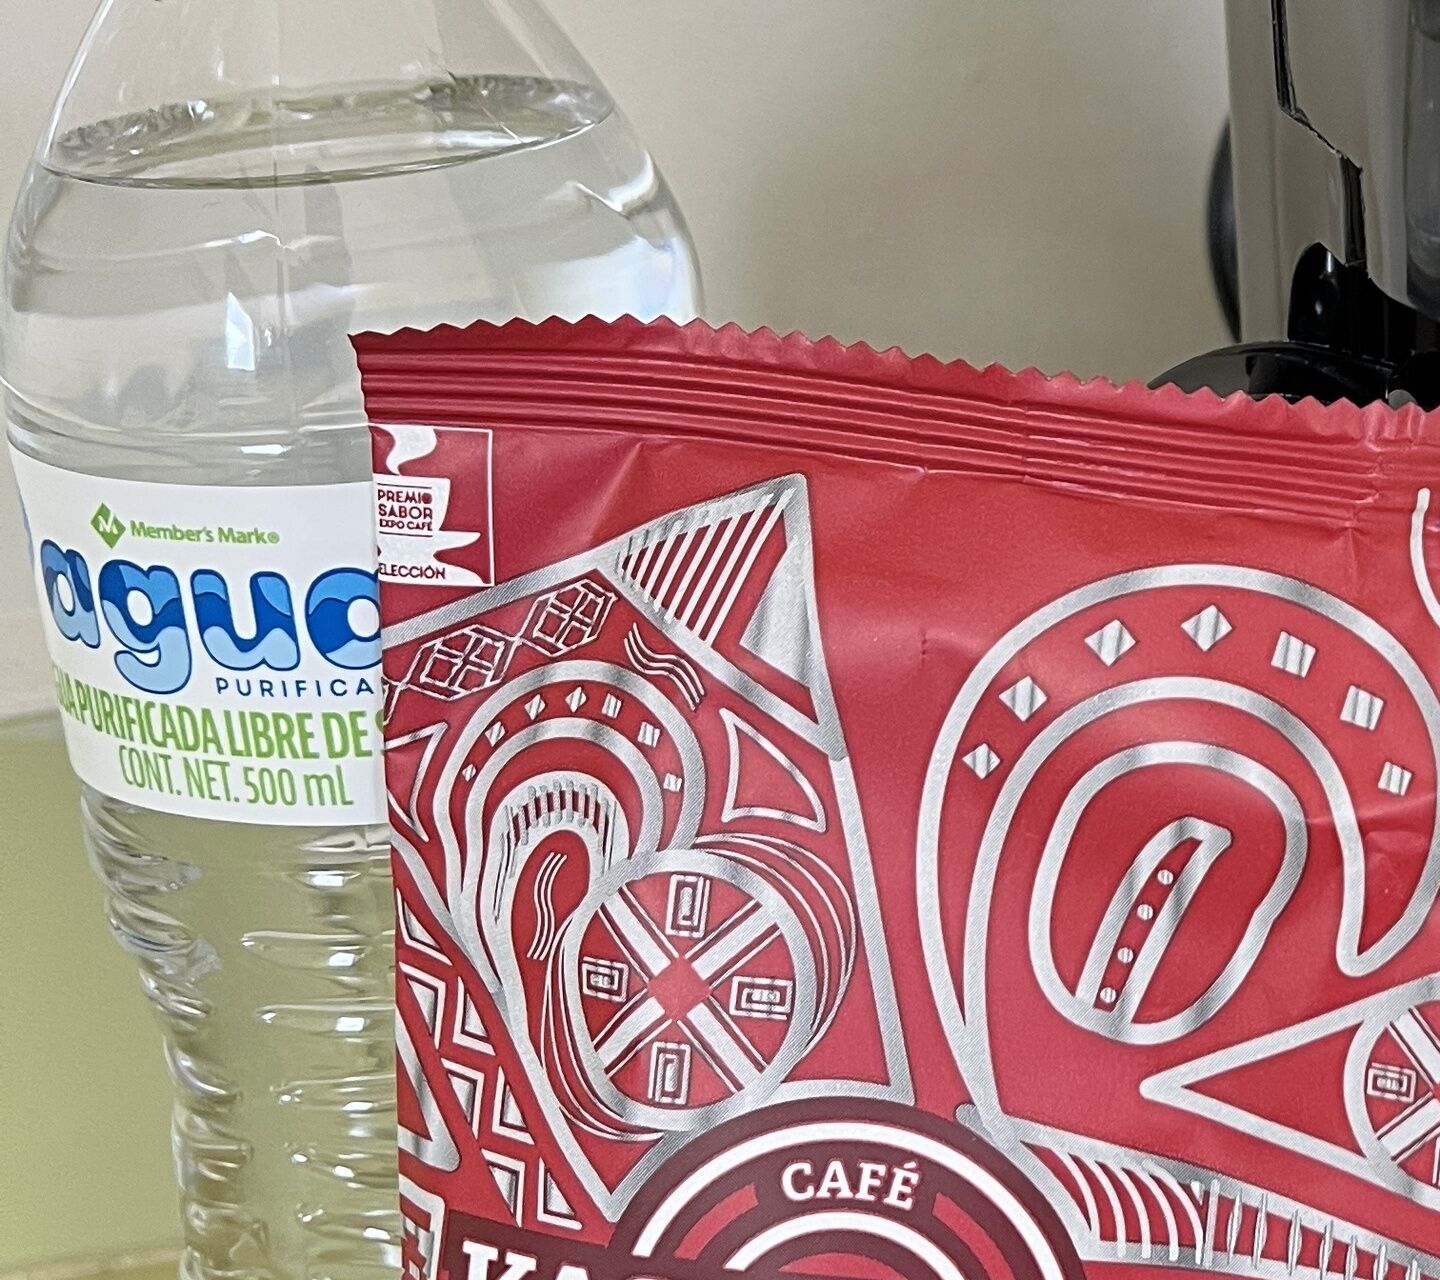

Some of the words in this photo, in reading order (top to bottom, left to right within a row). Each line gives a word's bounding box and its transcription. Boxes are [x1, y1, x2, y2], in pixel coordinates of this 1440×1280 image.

[377, 488, 433, 505] PREMIO
[378, 503, 433, 520] SABOR
[130, 520, 215, 543] Member's
[215, 676, 375, 698] PURIFICA
[75, 678, 225, 756] PURIFICADA
[223, 708, 321, 760] LIBRE
[321, 710, 373, 760] DE
[118, 745, 182, 796] CONT.
[182, 756, 240, 803] NET.
[242, 766, 298, 806] 500
[781, 1160, 920, 1211] CAFÉ
